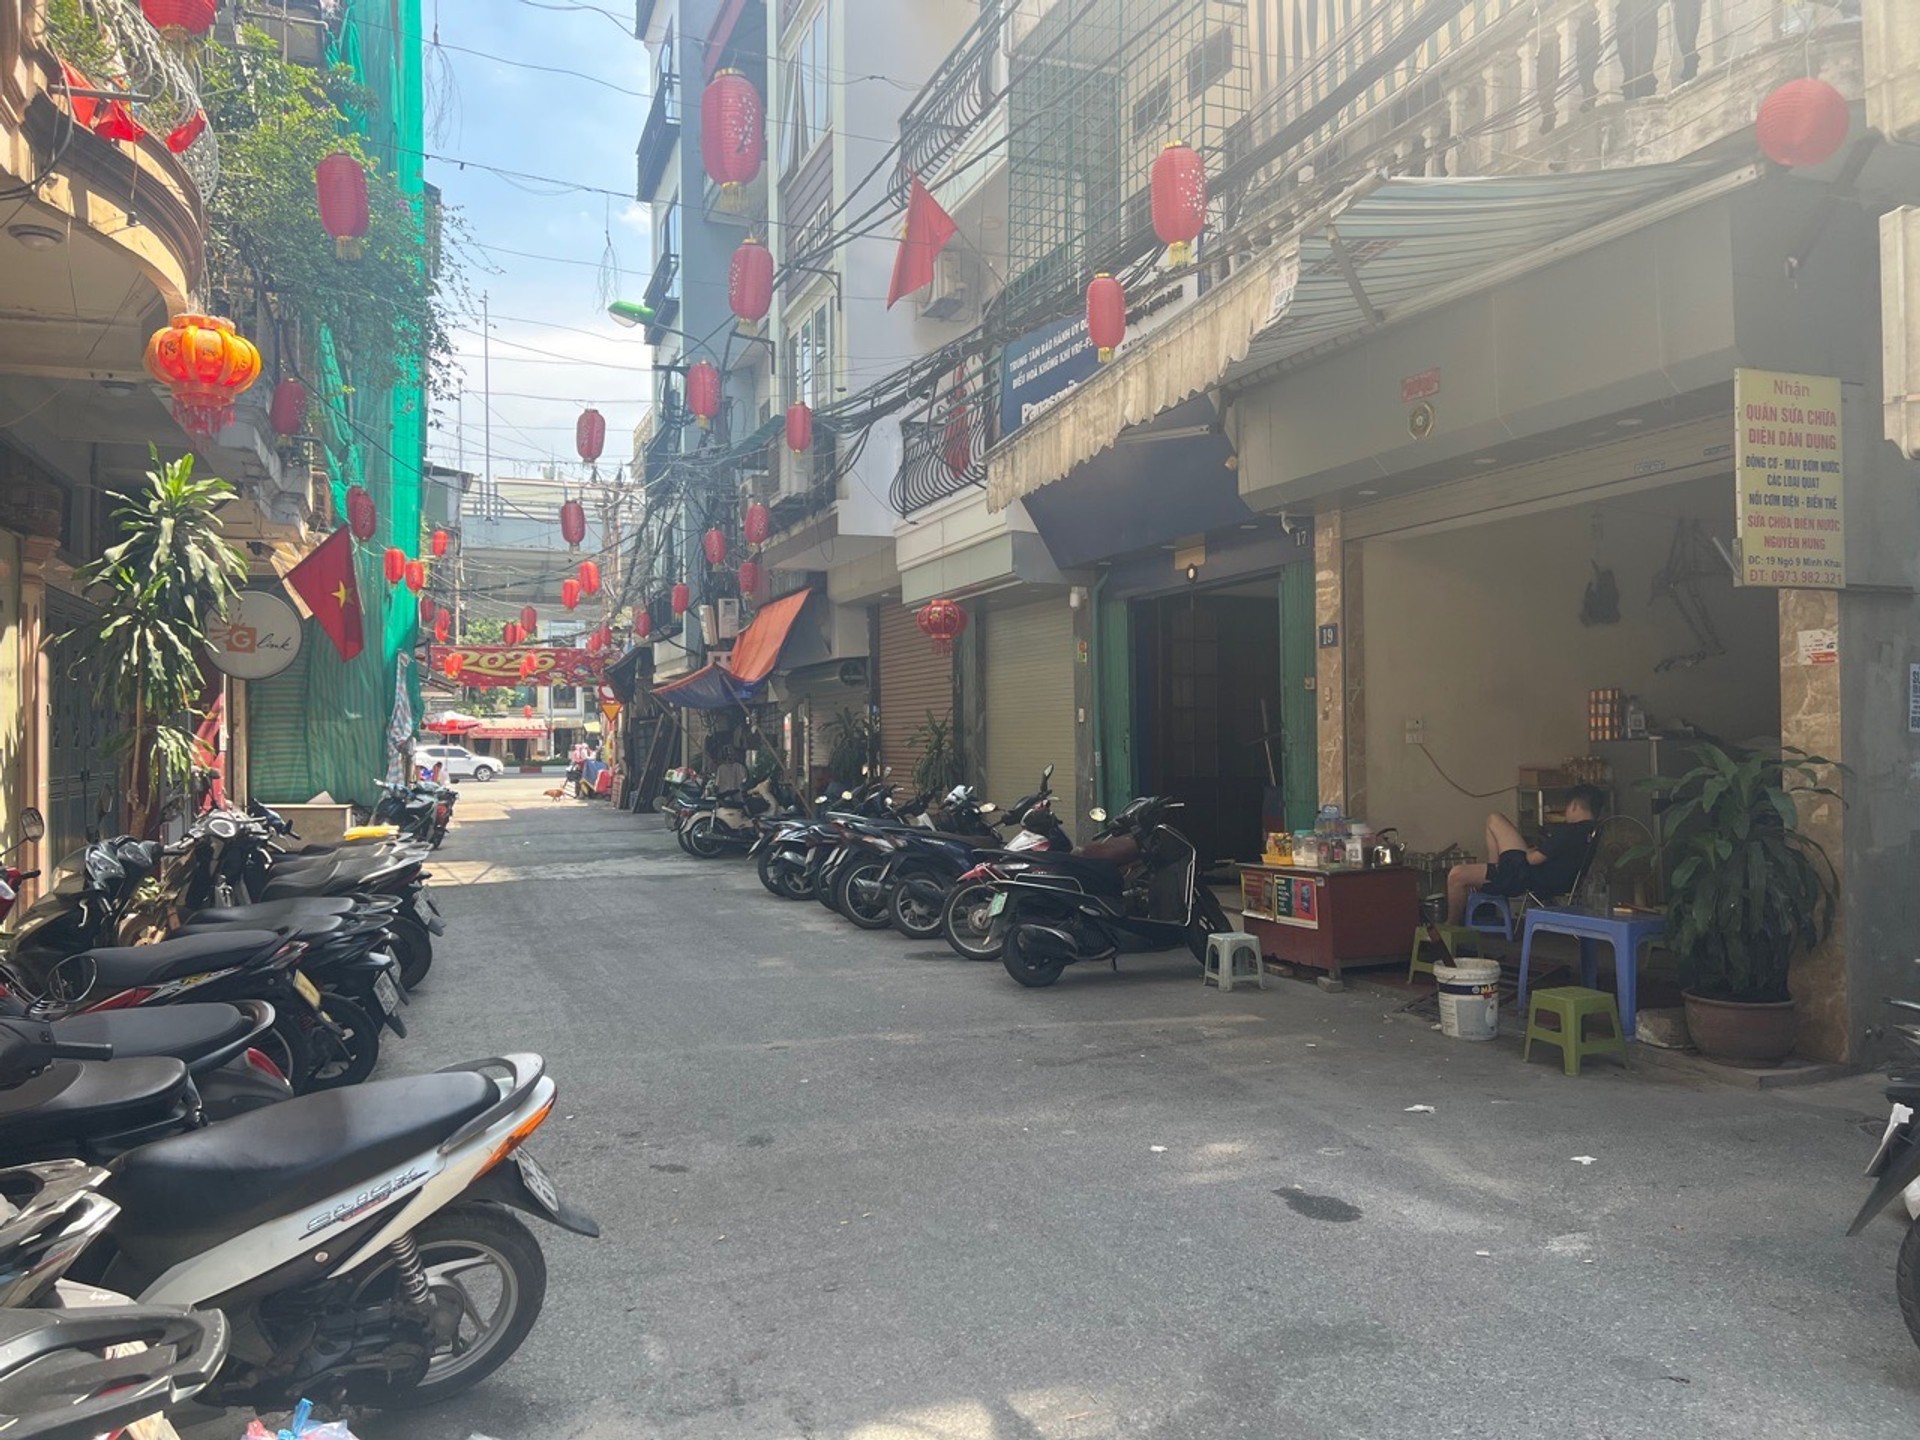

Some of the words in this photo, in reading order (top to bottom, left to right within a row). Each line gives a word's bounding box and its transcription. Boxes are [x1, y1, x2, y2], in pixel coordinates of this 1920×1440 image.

[1774, 379, 1810, 400] Nhận
[1766, 555, 1776, 566] 19
[1802, 557, 1822, 567] Minh
[1749, 569, 1769, 583] ĐT:
[1322, 628, 1334, 645] 19
[458, 650, 557, 673] 2026
